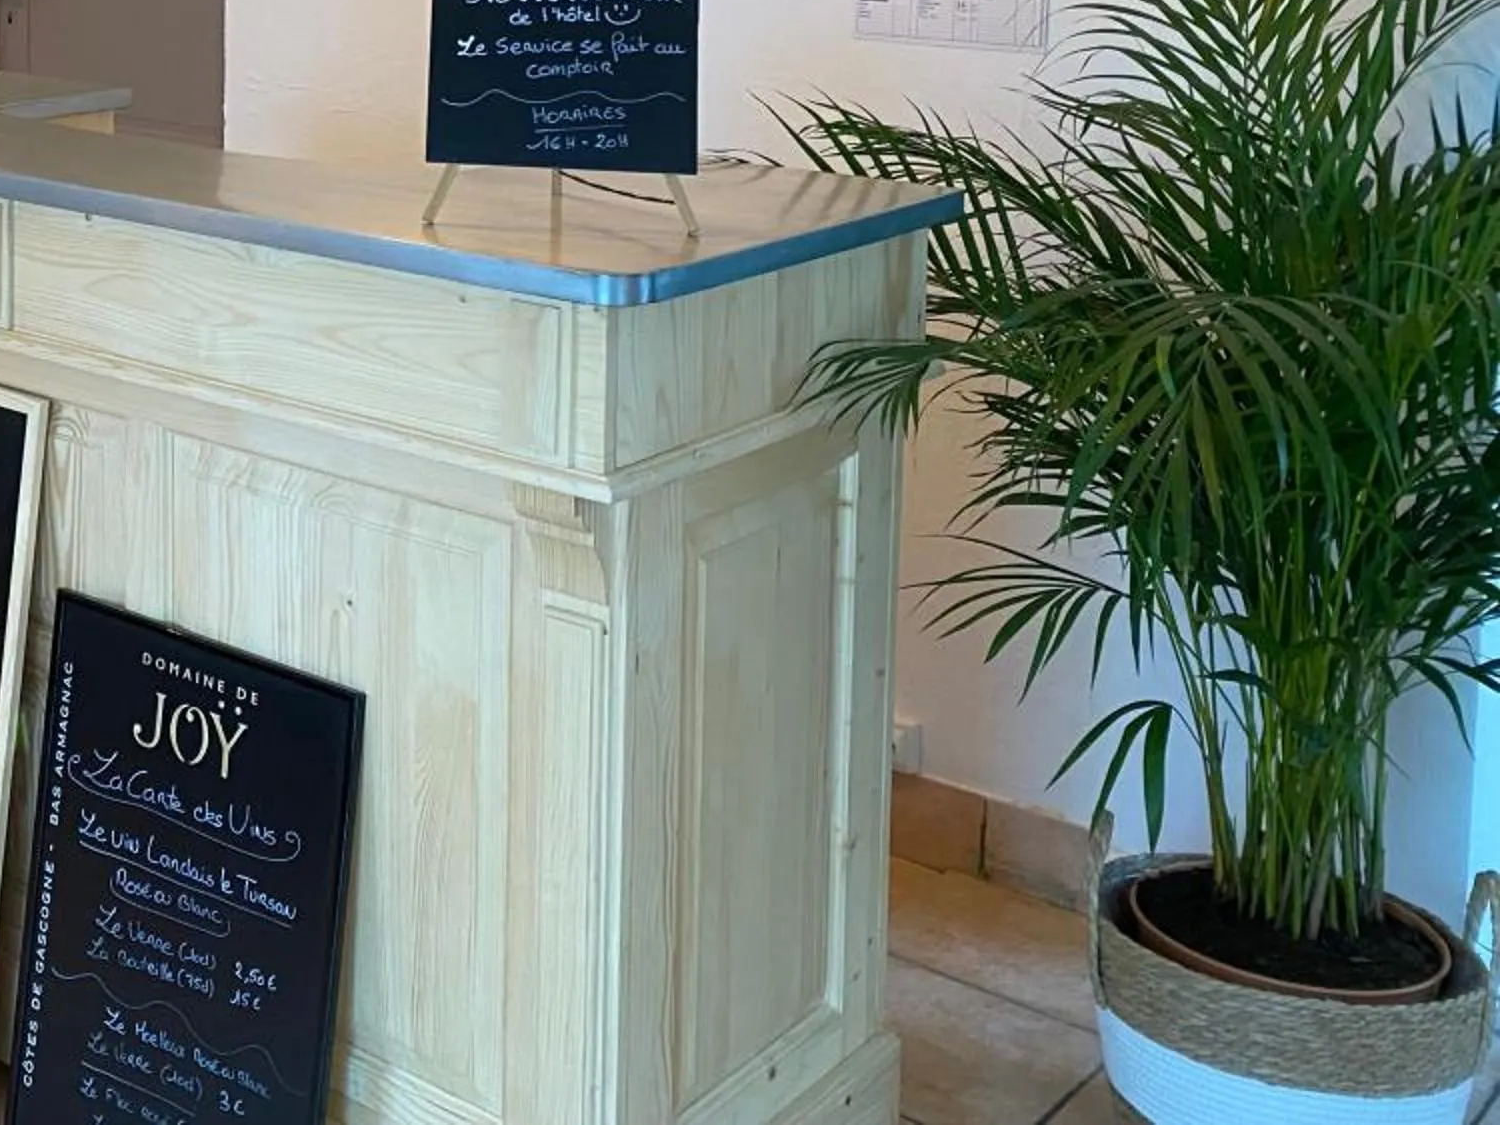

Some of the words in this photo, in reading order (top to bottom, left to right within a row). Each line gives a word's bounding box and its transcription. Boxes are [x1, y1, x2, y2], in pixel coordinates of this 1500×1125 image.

[509, 11, 533, 25] de
[457, 35, 488, 57] Le
[579, 41, 604, 54] se
[611, 30, 651, 62] fait
[654, 42, 687, 55] au
[595, 133, 629, 149] 20H
[142, 652, 225, 694] DOMAINE
[236, 686, 259, 706] DE
[54, 662, 74, 777] ARMAGNAC
[49, 786, 62, 826] BAS
[83, 748, 123, 792] La
[126, 770, 186, 814] Carte
[193, 800, 224, 828] des
[228, 803, 277, 846] Vins
[79, 808, 107, 842] Le
[147, 835, 215, 888] Landais
[221, 867, 234, 894] le
[35, 860, 56, 974] GASCOGNE
[95, 904, 125, 939] Le
[177, 894, 223, 924] Blanc
[30, 982, 44, 1011] DE
[103, 1006, 127, 1035] Le
[21, 1020, 39, 1088] CÔTES
[219, 1090, 245, 1116] 3€
